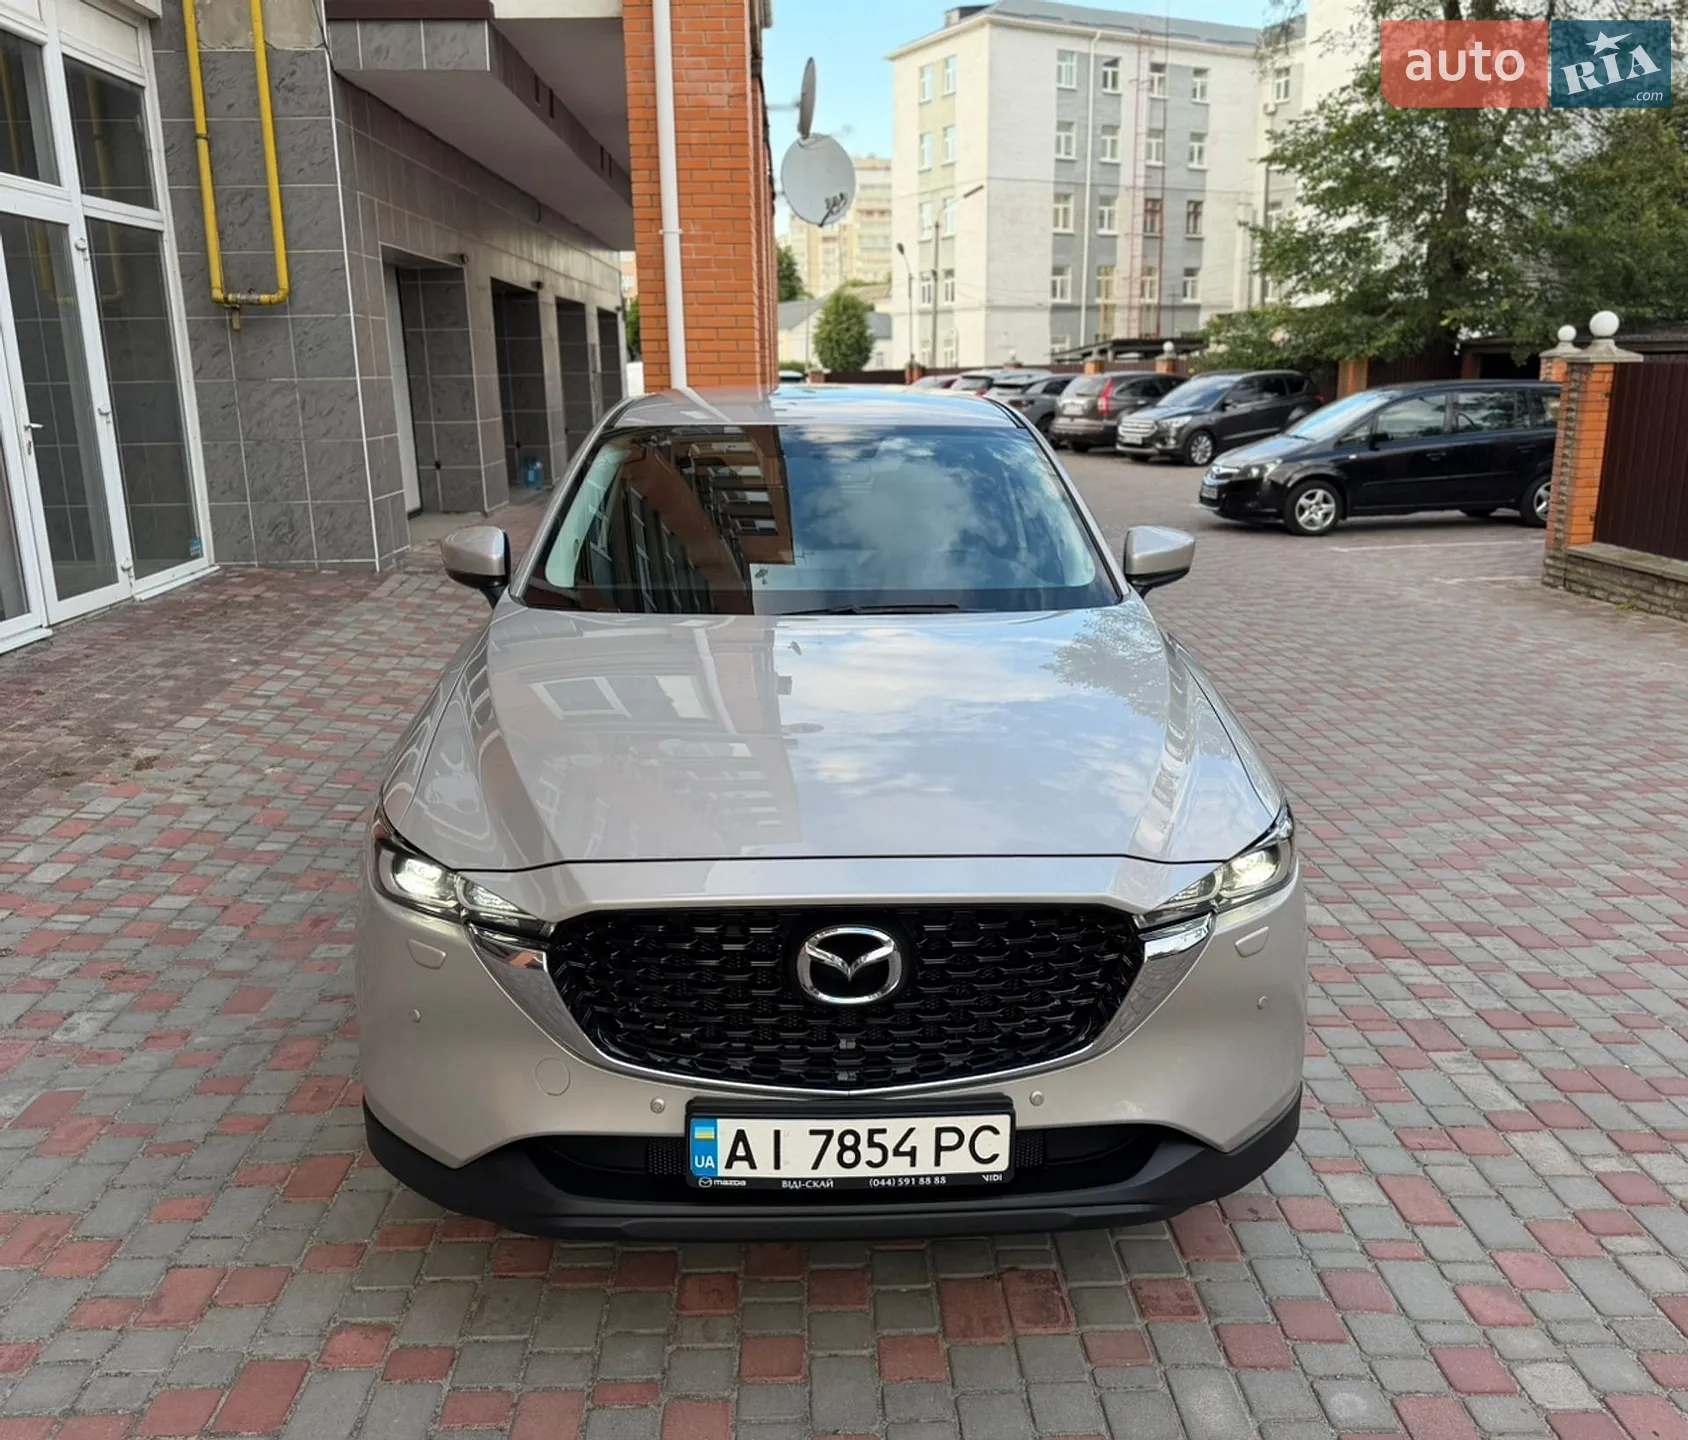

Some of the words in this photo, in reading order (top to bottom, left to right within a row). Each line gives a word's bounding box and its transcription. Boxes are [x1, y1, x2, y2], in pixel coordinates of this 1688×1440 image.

[808, 1127, 917, 1171] 7854
[933, 1125, 1001, 1167] PC
[694, 1155, 715, 1168] UA
[869, 1178, 896, 1188] (044)
[898, 1177, 916, 1186] 591
[918, 1176, 932, 1185] 88
[933, 1175, 947, 1185] 88
[982, 1173, 1003, 1182] VIDI
[781, 1179, 834, 1190] ВІДІ-СКАЙ
